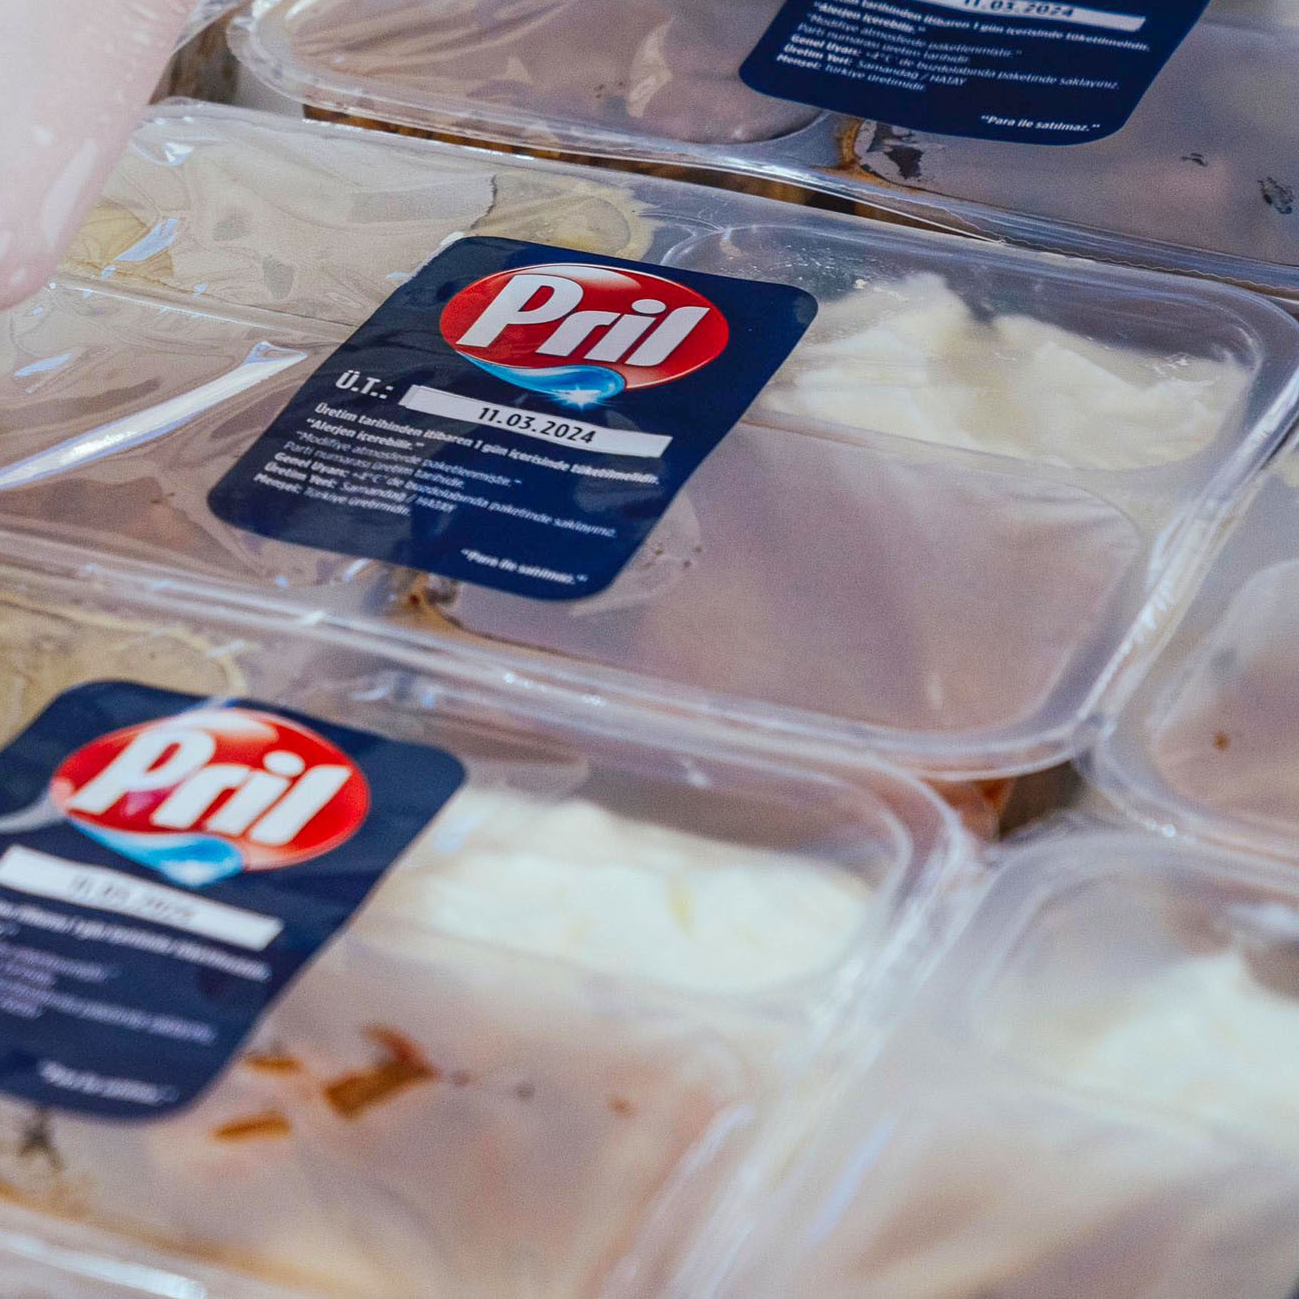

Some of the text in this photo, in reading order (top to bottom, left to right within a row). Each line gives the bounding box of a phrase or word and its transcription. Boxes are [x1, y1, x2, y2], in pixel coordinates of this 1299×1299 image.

[455, 274, 710, 367] Pril
[315, 403, 358, 422] Üretim
[357, 414, 423, 437] tarihinden
[335, 369, 597, 444] Ü.T.: 11.03.2024
[68, 729, 352, 846] Pril
